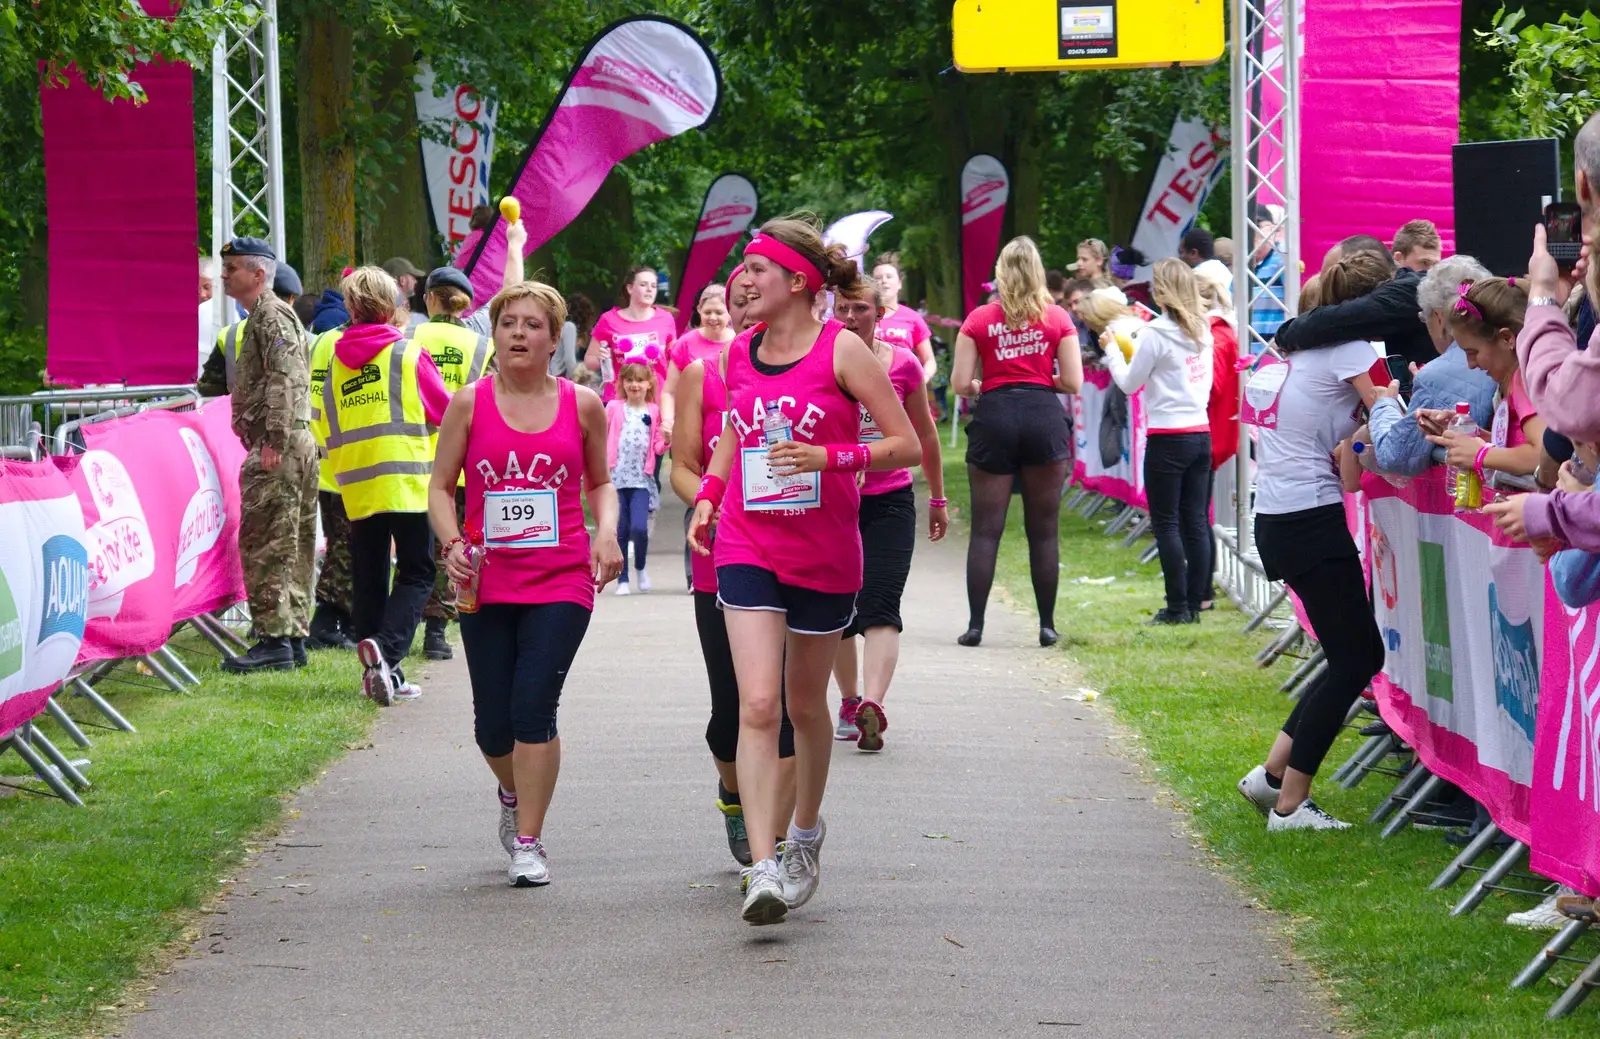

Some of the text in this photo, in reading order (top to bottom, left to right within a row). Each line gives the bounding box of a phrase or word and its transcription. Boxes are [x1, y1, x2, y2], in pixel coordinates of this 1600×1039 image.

[998, 329, 1044, 349] Music
[994, 341, 1050, 361] Variety
[340, 391, 387, 409] MARSHAL
[476, 450, 569, 491] RACE
[501, 504, 535, 521] 199
